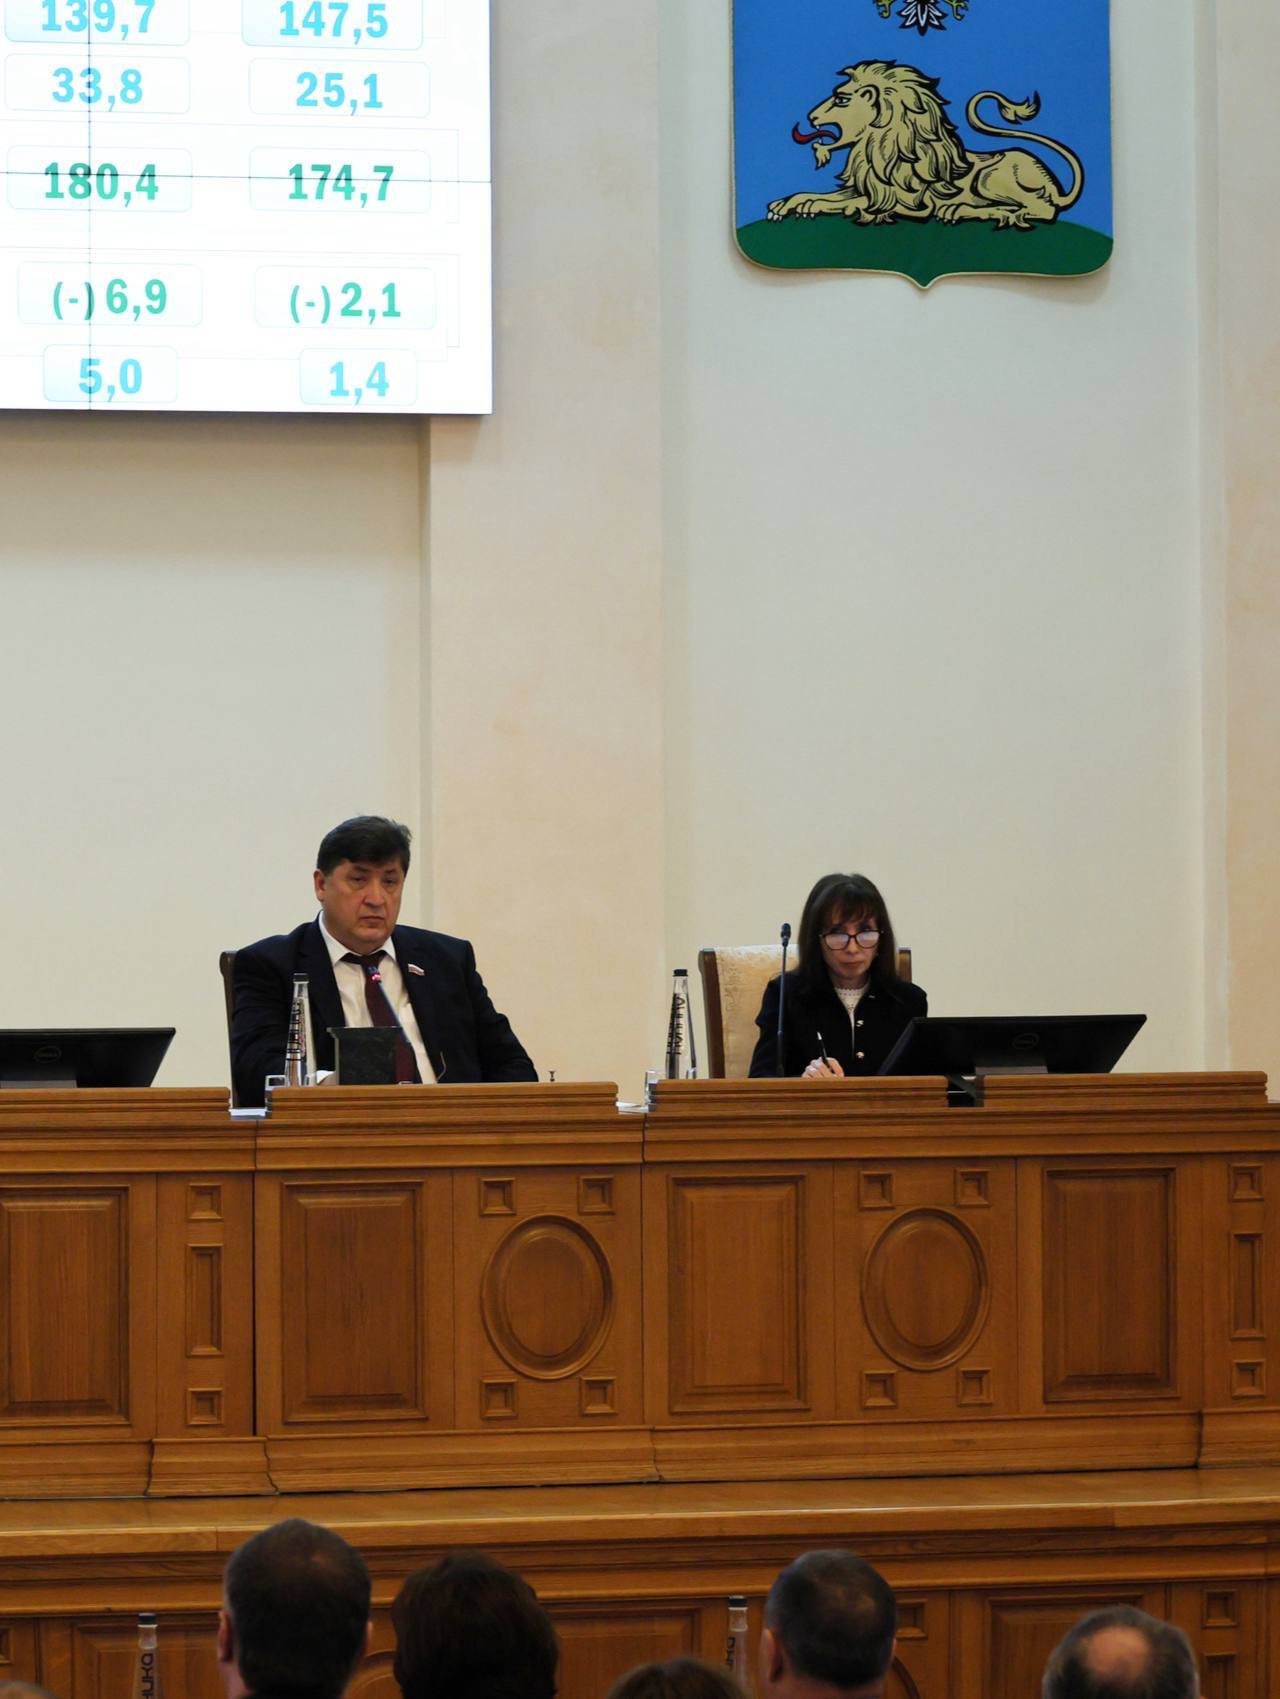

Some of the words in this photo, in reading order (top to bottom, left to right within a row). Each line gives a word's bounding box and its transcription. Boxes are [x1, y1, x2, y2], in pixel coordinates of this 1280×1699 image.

[42, 0, 156, 41] 139,7
[279, 1, 388, 43] 147,5
[52, 66, 143, 113] 33,8
[296, 71, 383, 114] 25,1
[44, 162, 159, 207] 180,4
[289, 163, 394, 208] 174,7
[79, 357, 143, 403] 5,0
[330, 361, 390, 405] 1,4
